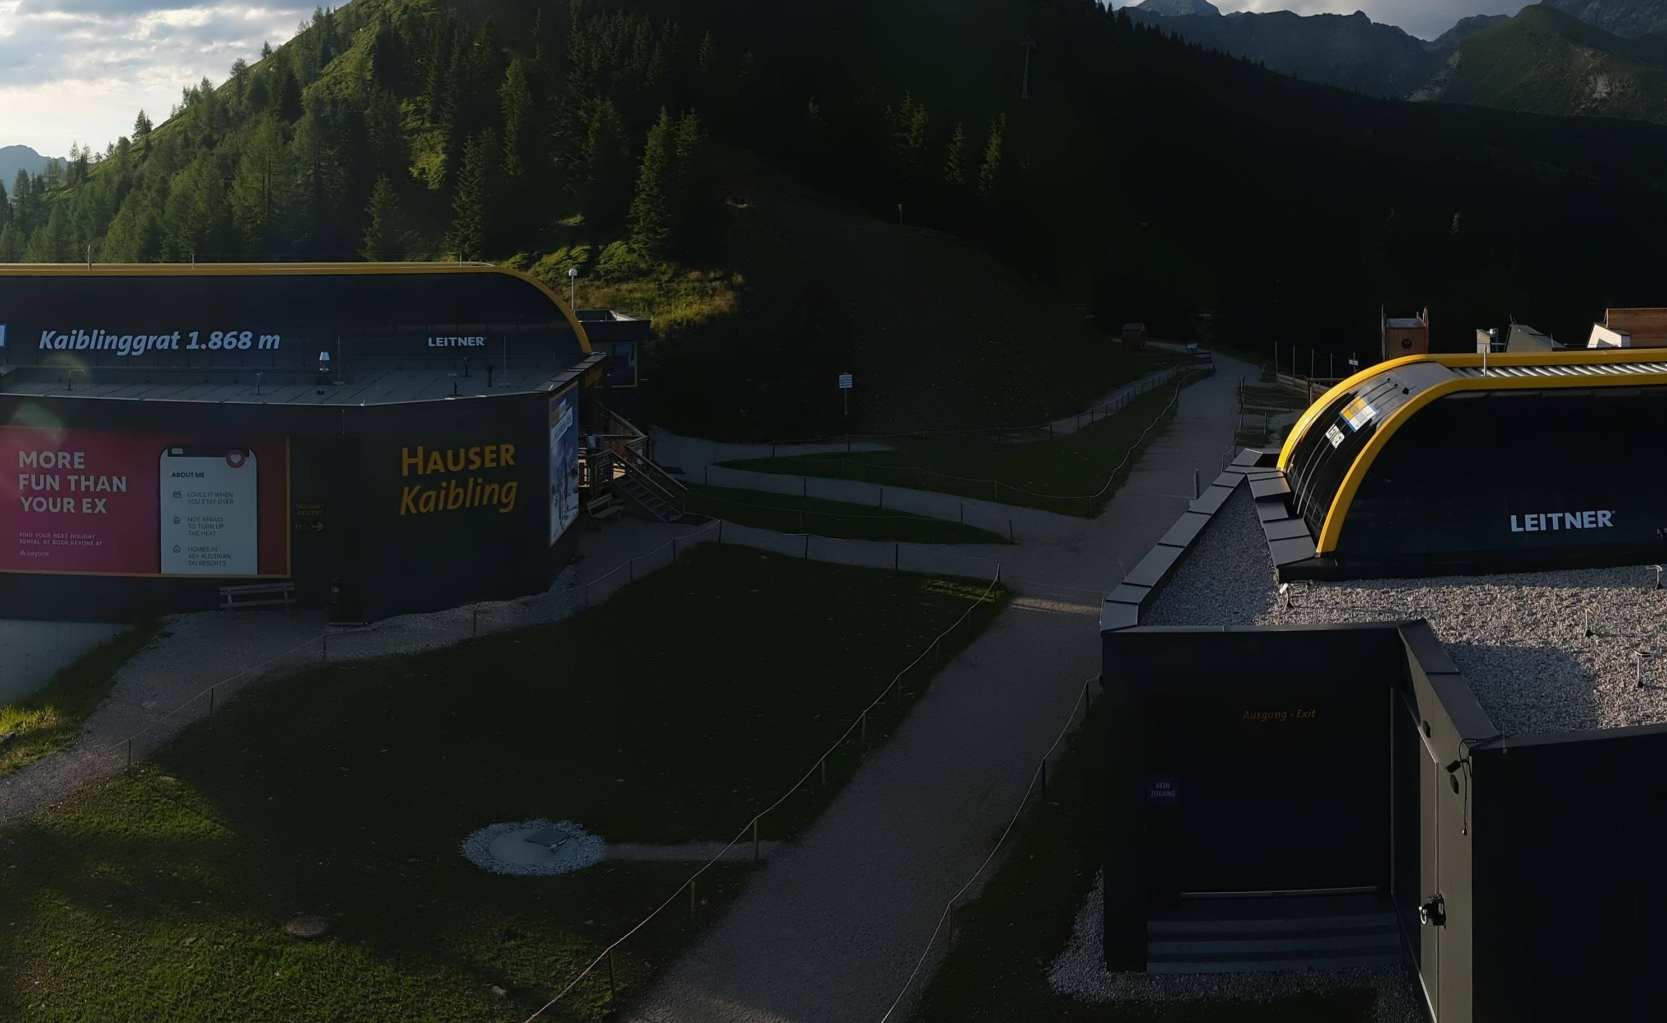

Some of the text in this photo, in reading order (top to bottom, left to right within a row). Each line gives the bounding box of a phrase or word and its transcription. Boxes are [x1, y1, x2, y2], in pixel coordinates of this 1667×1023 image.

[39, 330, 281, 356] Kaiblinggrat 1.868 m
[428, 336, 485, 347] LEITNER
[18, 450, 85, 469] MORE
[401, 443, 516, 477] HAUSER
[18, 473, 127, 492] FUN THAN
[20, 496, 107, 514] YOUR EX
[400, 477, 519, 515] Kaibling
[1510, 510, 1614, 532] LEITNER
[27, 550, 50, 558] keyone
[1242, 710, 1288, 722] Ausgang
[1296, 708, 1316, 718] Exit
[1150, 789, 1176, 798] ZUGANG
[1155, 781, 1171, 789] KEIN
